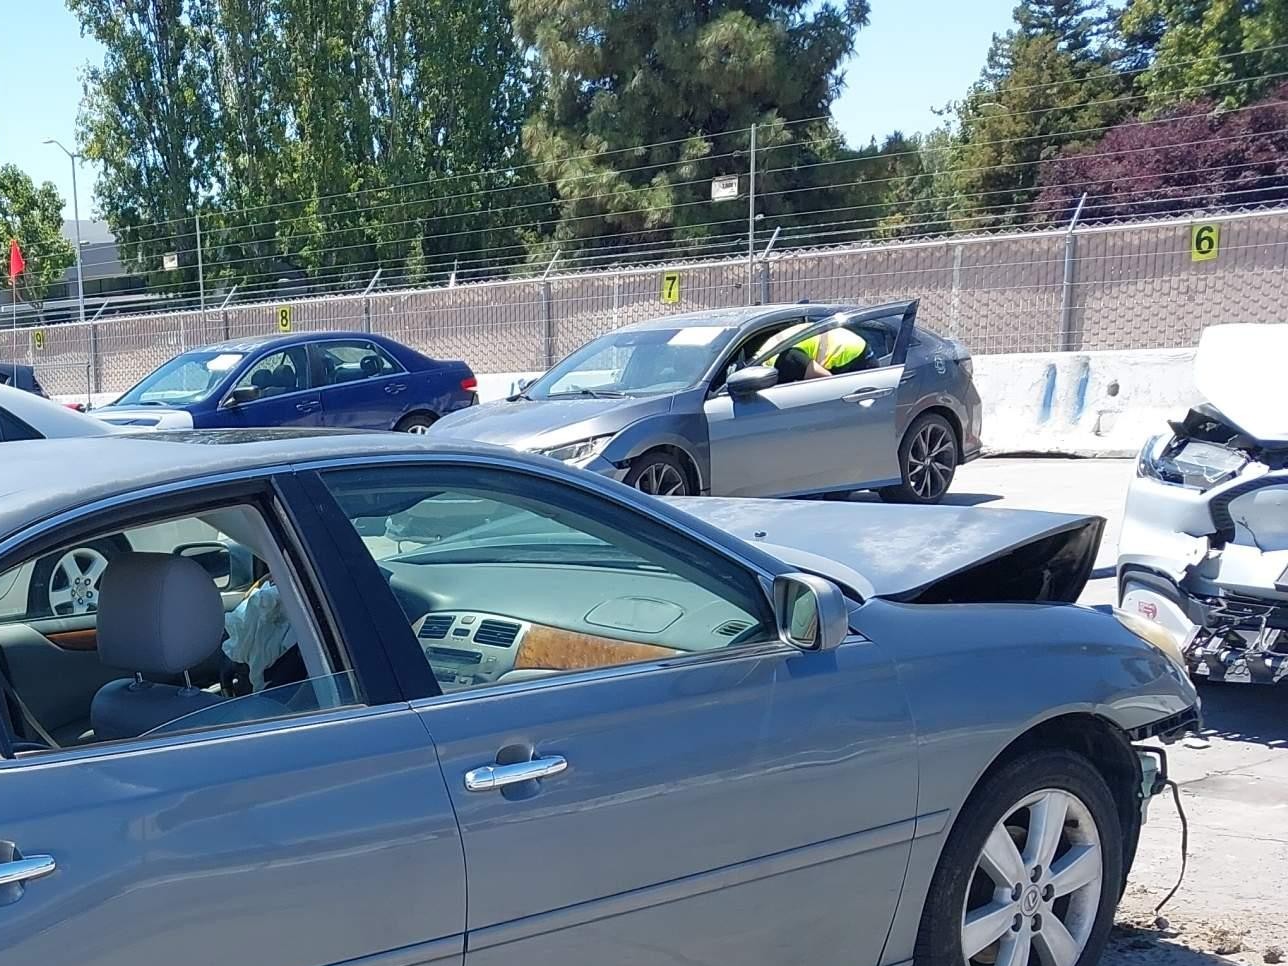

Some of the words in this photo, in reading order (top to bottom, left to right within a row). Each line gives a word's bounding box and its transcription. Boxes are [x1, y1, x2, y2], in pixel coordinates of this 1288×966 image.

[1195, 225, 1214, 254] 6
[665, 276, 677, 298] 7
[280, 309, 289, 327] 8
[35, 332, 42, 348] 9
